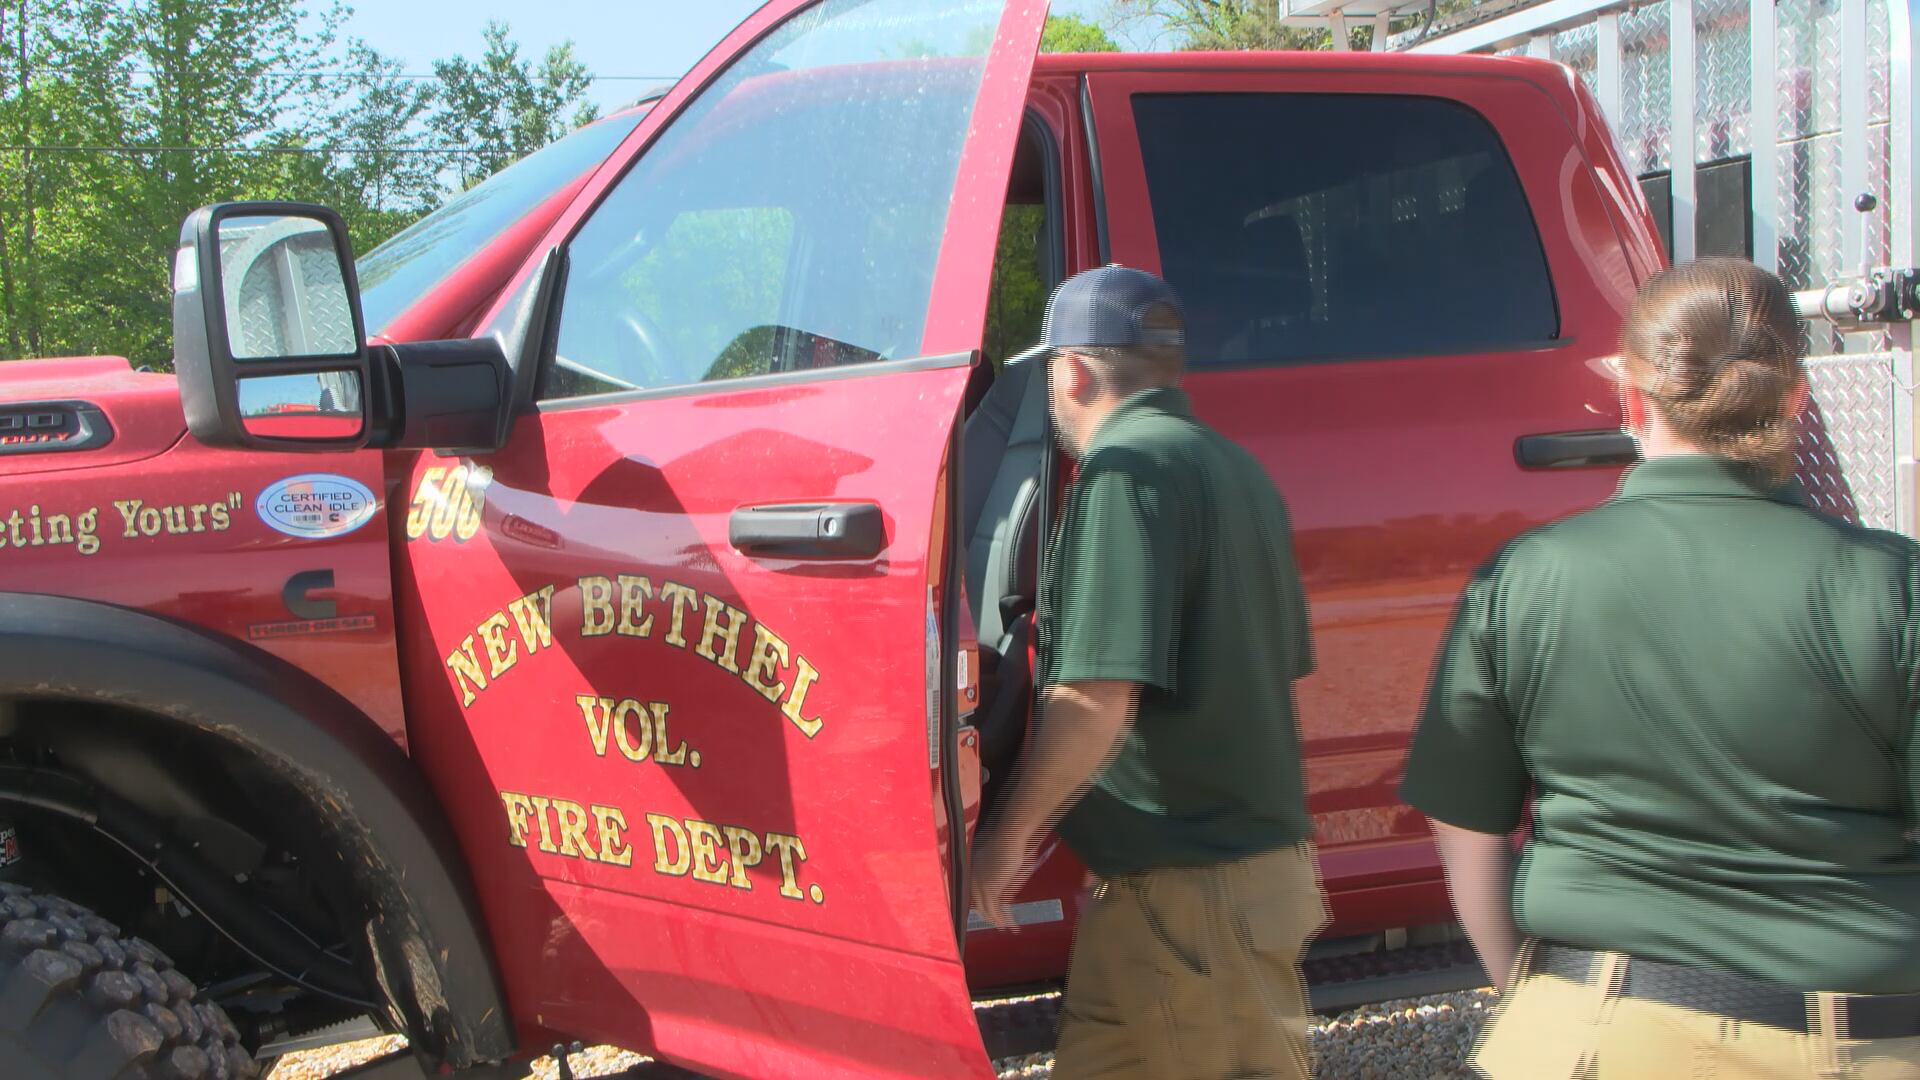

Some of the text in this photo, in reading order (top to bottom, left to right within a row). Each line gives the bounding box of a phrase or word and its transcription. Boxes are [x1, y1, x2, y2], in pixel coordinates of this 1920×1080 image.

[112, 491, 242, 538] Yours"
[274, 502, 360, 513] CLEAN IDLE
[280, 491, 353, 503] CERTIFIED
[446, 584, 555, 708] NEW
[577, 574, 825, 740] BETHEL
[576, 695, 701, 768] VOL.
[500, 791, 825, 905] FIRE DEPT.
